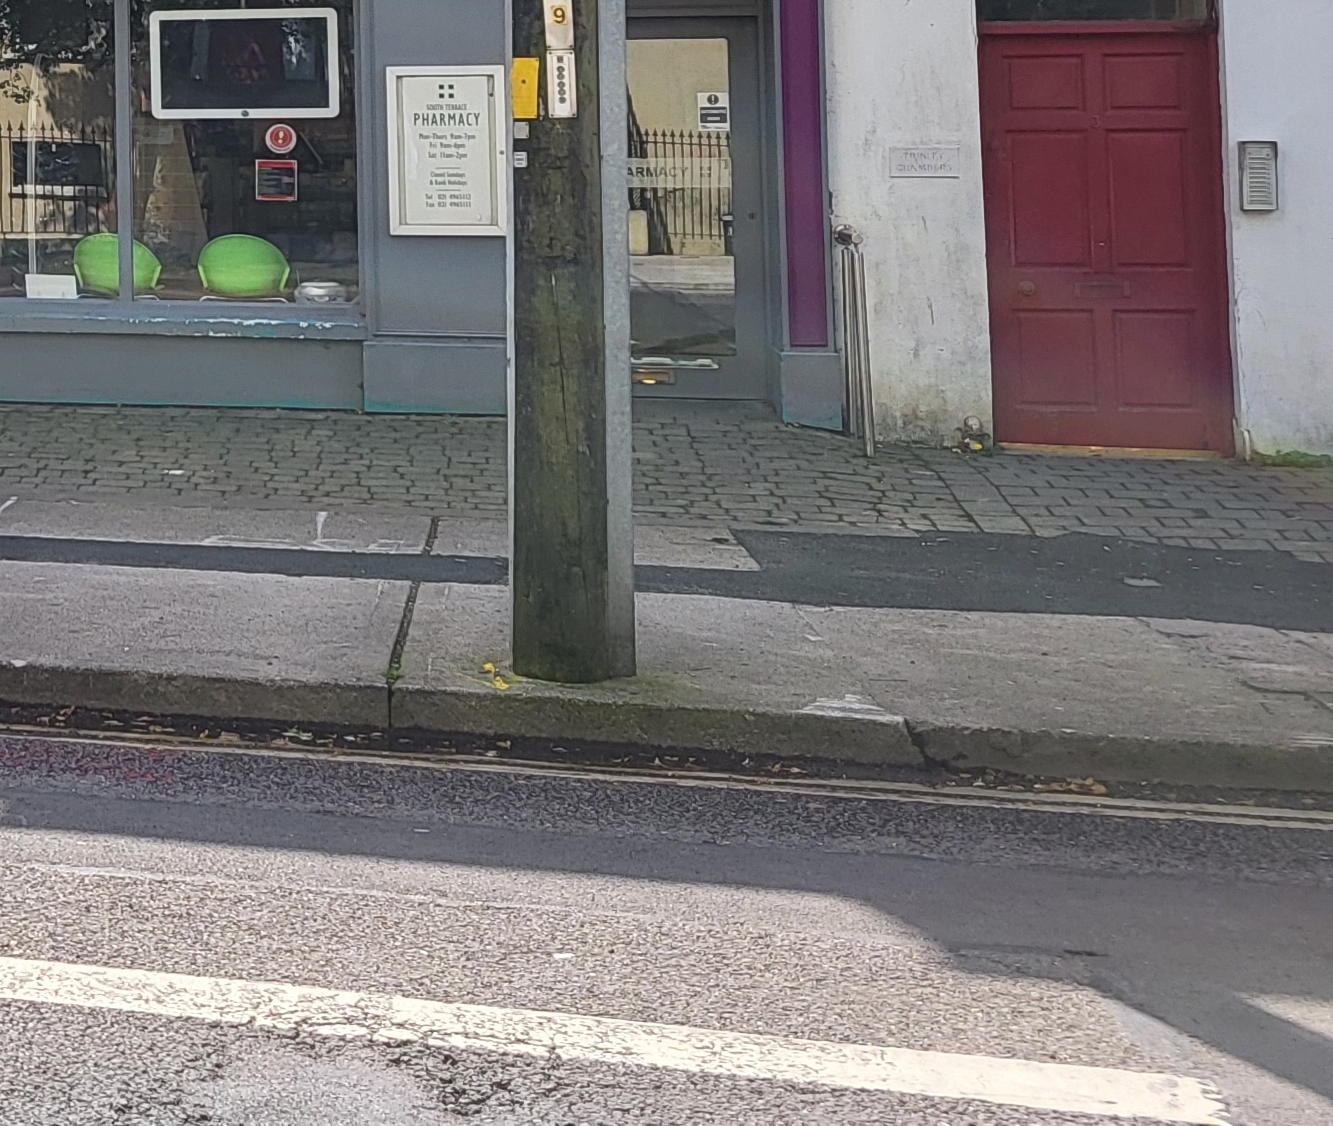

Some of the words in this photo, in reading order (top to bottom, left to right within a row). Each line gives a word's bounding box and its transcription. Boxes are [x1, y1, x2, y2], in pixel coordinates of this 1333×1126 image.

[552, 7, 567, 24] 9
[413, 112, 481, 127] PHARMACY
[627, 166, 689, 178] ARMACY
